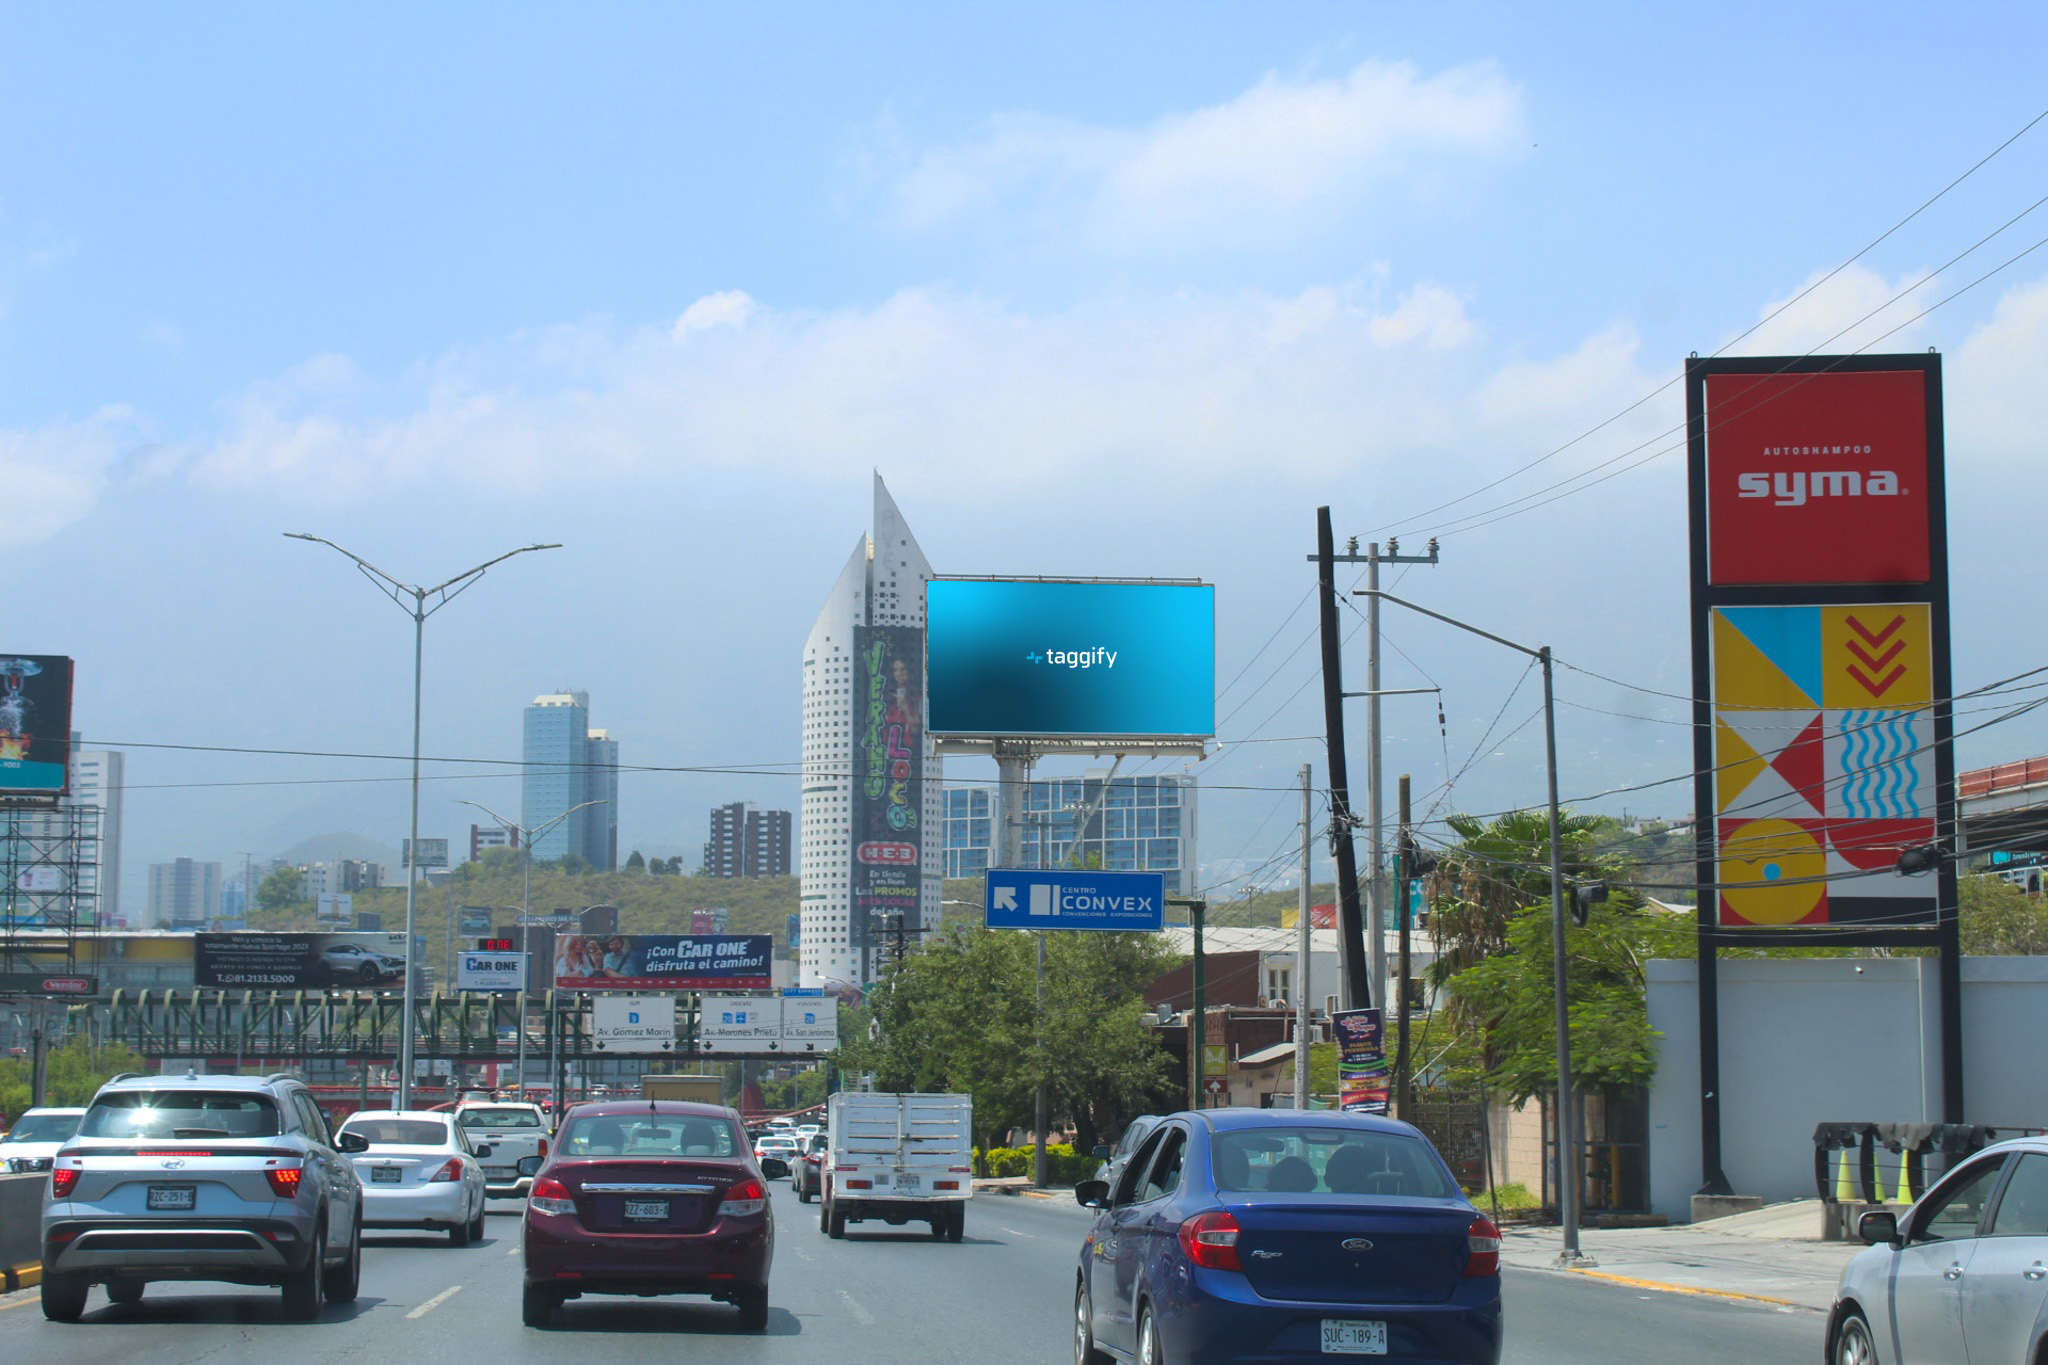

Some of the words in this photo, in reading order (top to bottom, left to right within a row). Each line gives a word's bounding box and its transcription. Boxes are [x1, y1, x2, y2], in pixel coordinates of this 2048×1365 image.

[1763, 445, 1871, 456] AUTOSHAMPOO
[1738, 470, 1898, 507] syma
[1046, 646, 1118, 668] taggify
[862, 640, 886, 800] VERANO
[887, 724, 912, 831] LOCO
[874, 887, 917, 897] PROMOS
[1062, 886, 1097, 894] CENTRO
[1062, 895, 1153, 911] CONVEX
[647, 947, 676, 960] ¡Con
[677, 940, 712, 959] CAR
[716, 941, 747, 957] ONE
[466, 957, 492, 971] CAR
[494, 961, 518, 971] ONE
[646, 958, 695, 973] disfruta
[698, 958, 711, 970] el
[713, 955, 764, 969] camino!
[49, 980, 83, 989] Vendor
[597, 1028, 610, 1036] Av.
[612, 1027, 644, 1036] Gómez
[646, 1027, 671, 1036] Morín
[718, 1028, 752, 1037] Morones
[754, 1028, 777, 1037] Prieto
[795, 1029, 806, 1037] San
[1323, 1327, 1386, 1345] SUC-189-A
